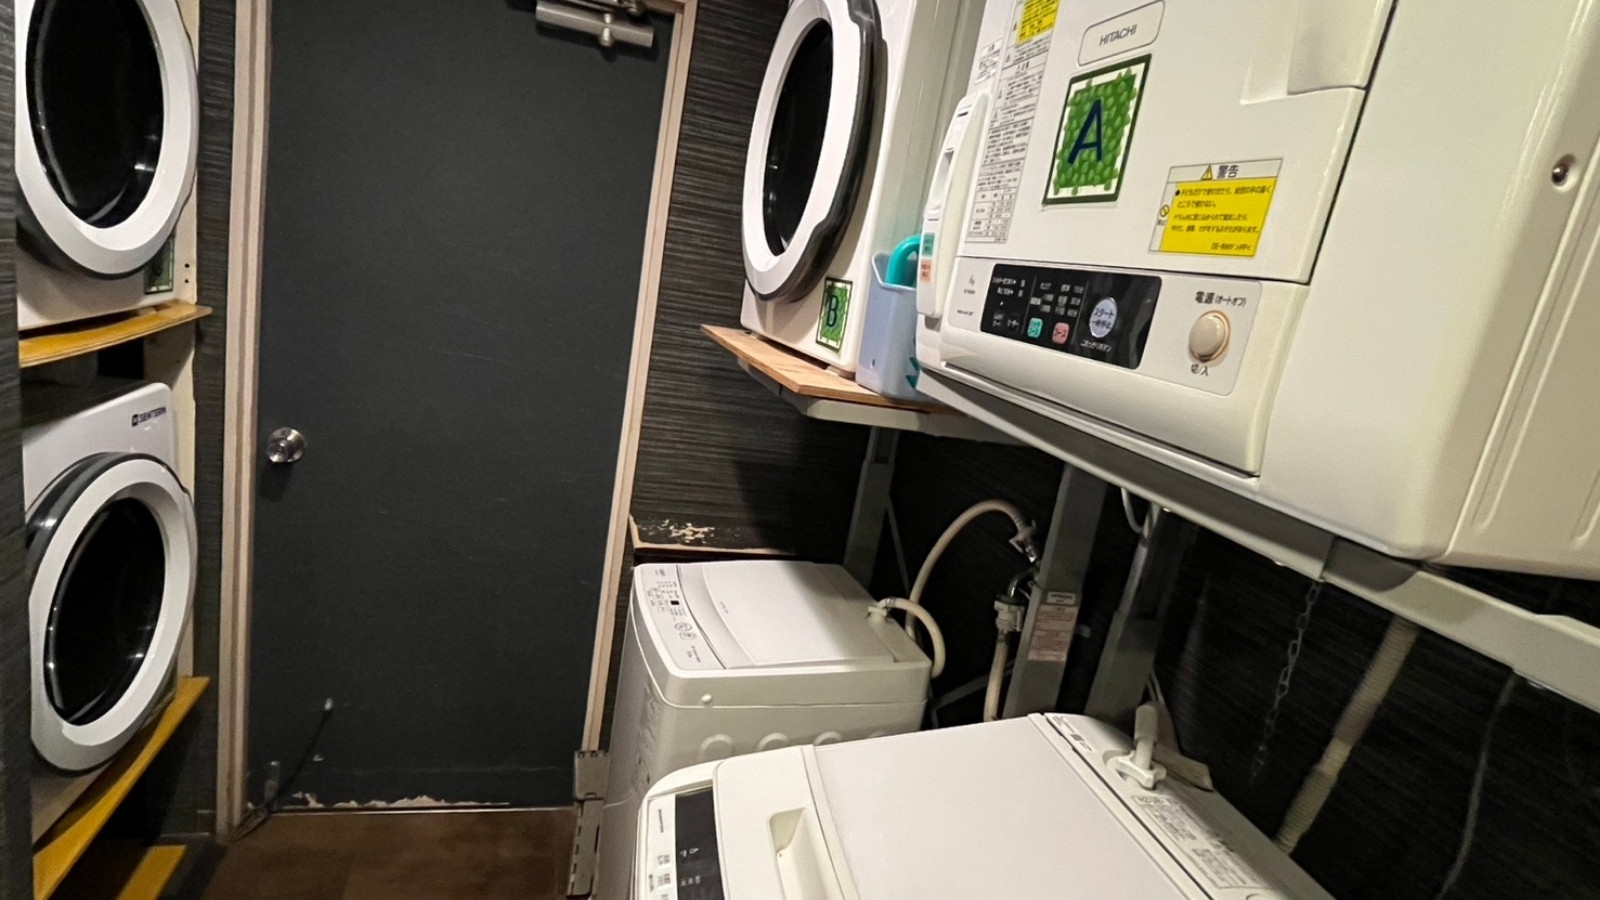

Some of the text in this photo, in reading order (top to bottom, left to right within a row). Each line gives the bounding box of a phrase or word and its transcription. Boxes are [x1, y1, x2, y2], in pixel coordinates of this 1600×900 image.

[1099, 24, 1138, 46] HITACHI
[1067, 98, 1102, 165] A
[1217, 165, 1239, 179] 警告
[826, 294, 839, 327] B
[1093, 307, 1115, 319] スタート
